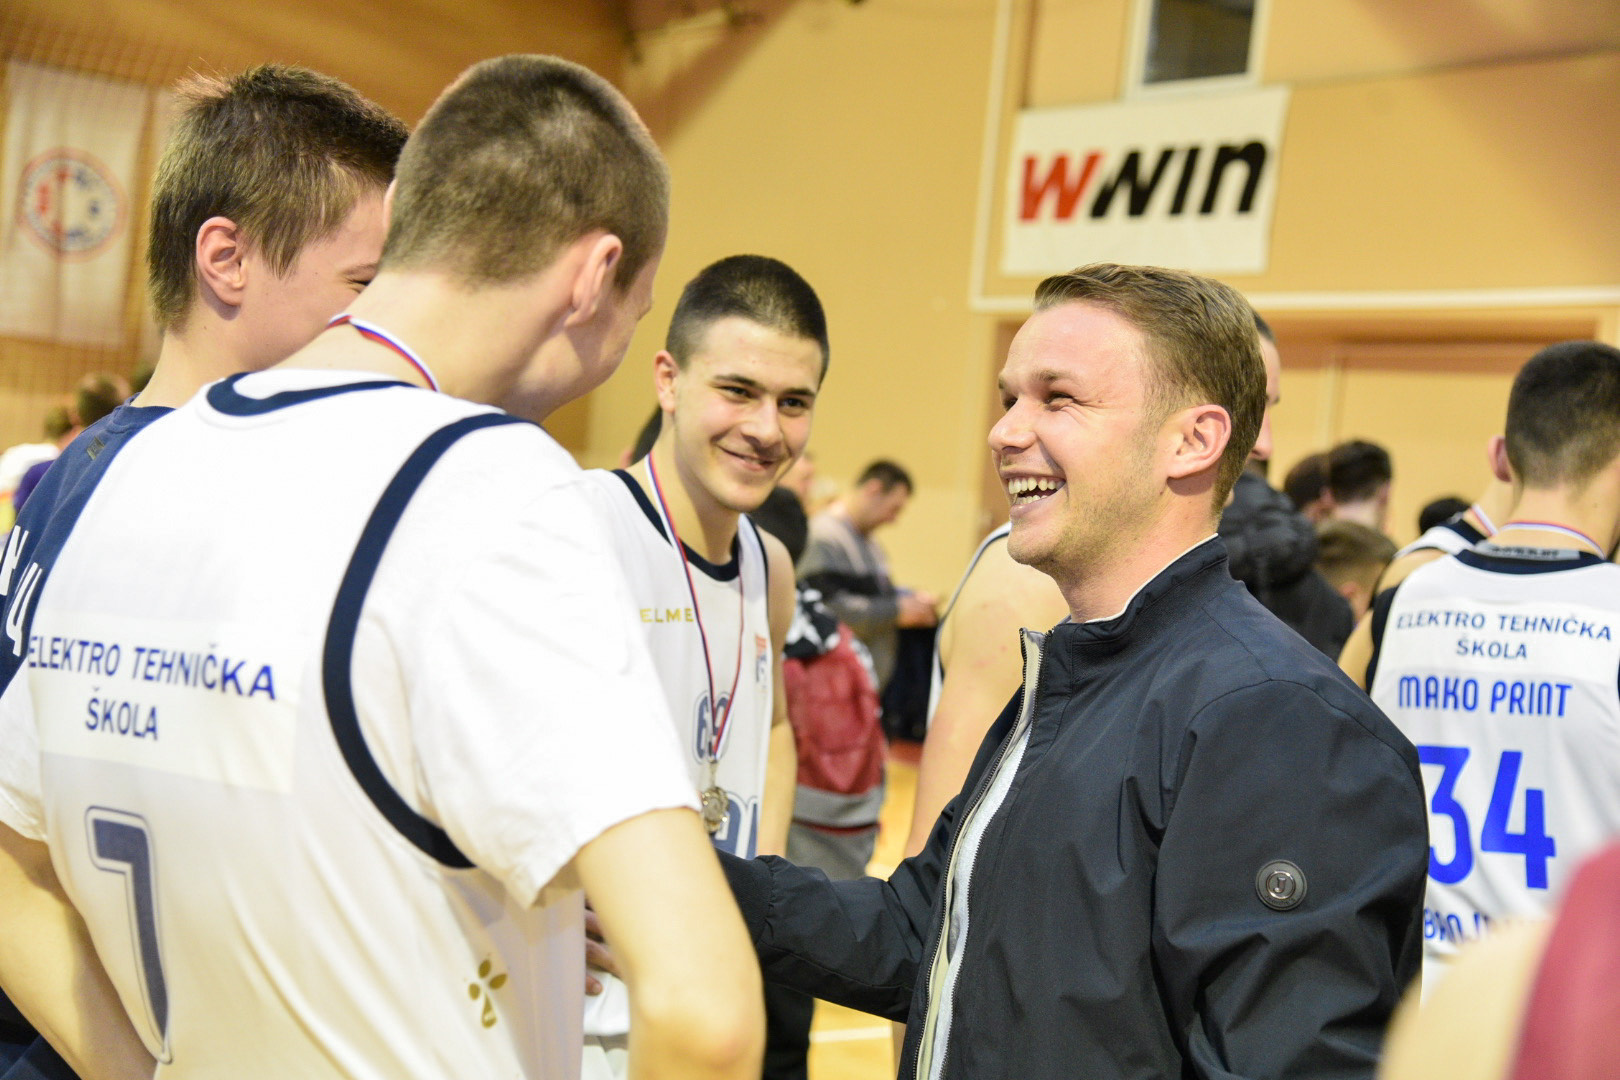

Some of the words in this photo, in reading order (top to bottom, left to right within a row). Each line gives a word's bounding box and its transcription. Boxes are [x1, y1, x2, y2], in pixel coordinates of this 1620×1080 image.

[639, 607, 694, 623] ELME
[1397, 610, 1486, 630] ELEKTRO
[1498, 613, 1612, 642] TEHNIČKA
[28, 636, 121, 677] ELEKTRO
[132, 642, 276, 700] TEHNIČKA
[1455, 633, 1528, 660] ŠKOLA
[85, 687, 158, 740] ŠKOLA
[1399, 675, 1479, 712] MAKO
[1490, 680, 1572, 718] PRINT
[1417, 745, 1556, 889] 34
[85, 805, 172, 1065] 7
